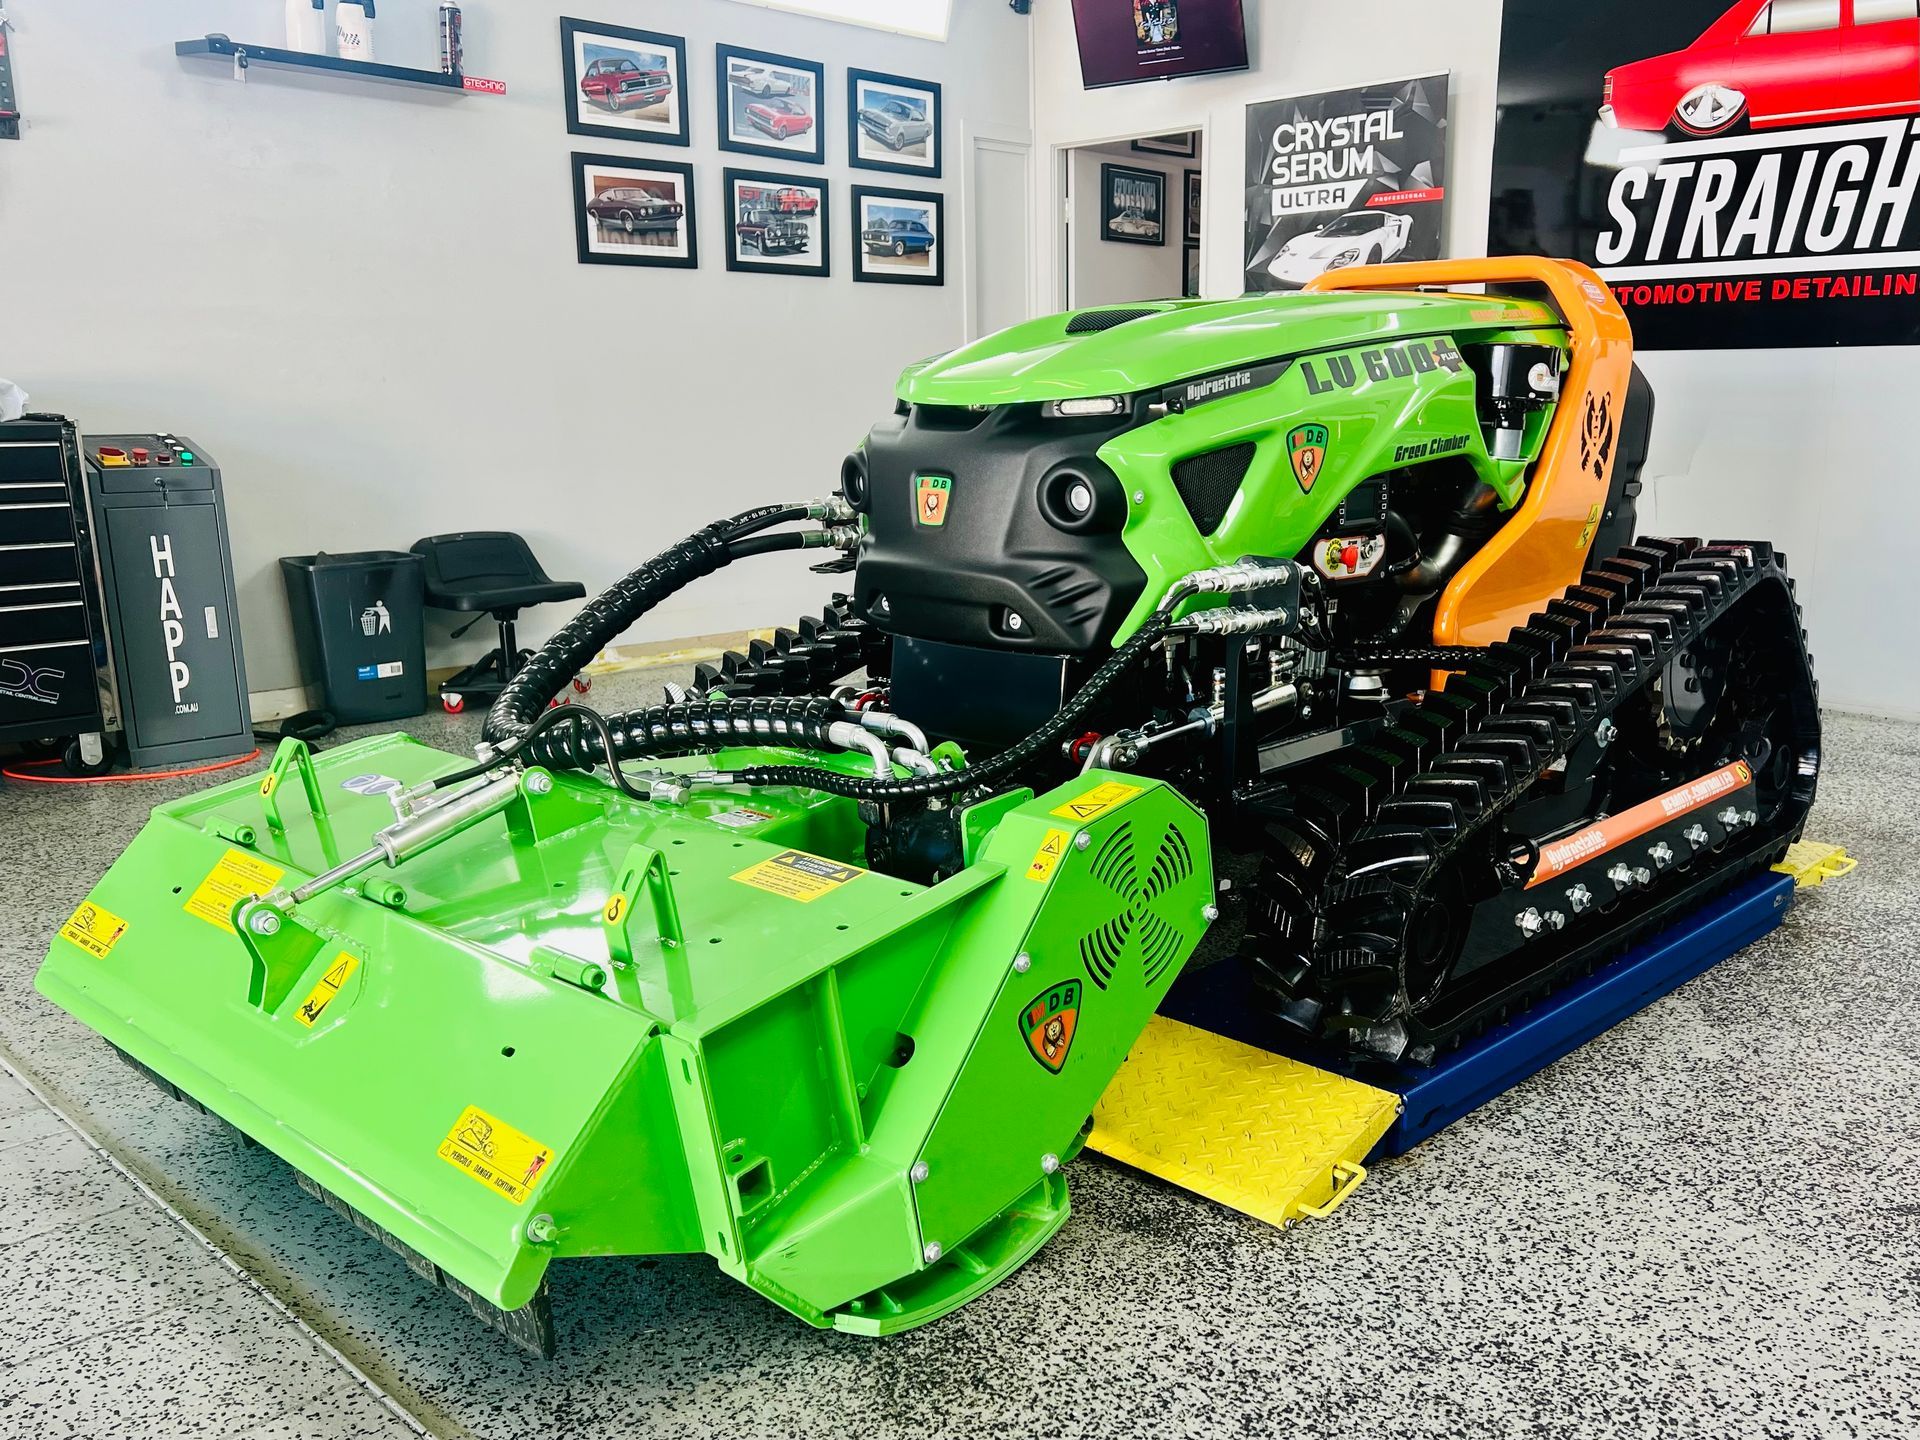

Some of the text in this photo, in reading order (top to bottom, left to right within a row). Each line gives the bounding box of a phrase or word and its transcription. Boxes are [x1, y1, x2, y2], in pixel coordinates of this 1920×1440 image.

[464, 78, 505, 91] GTECHNIQ
[1273, 110, 1404, 154] CRYSTAL
[1272, 145, 1374, 186] SERUM
[1280, 187, 1346, 209] ULTRA
[1374, 192, 1427, 203] PROFESSIONAL
[1595, 126, 1920, 264] STRAIGH
[1609, 280, 1762, 306] TOMOTIVE
[1772, 273, 1920, 301] DETAILIN
[1300, 343, 1459, 395] LV 600 PLUS
[1187, 371, 1251, 401] Hydrostatic
[1393, 434, 1471, 462] Green Climber
[150, 534, 191, 704] HAPP
[1546, 830, 1607, 871] Hydrostatic
[451, 1150, 472, 1168] PERICOLO
[473, 1164, 493, 1181] DANGER
